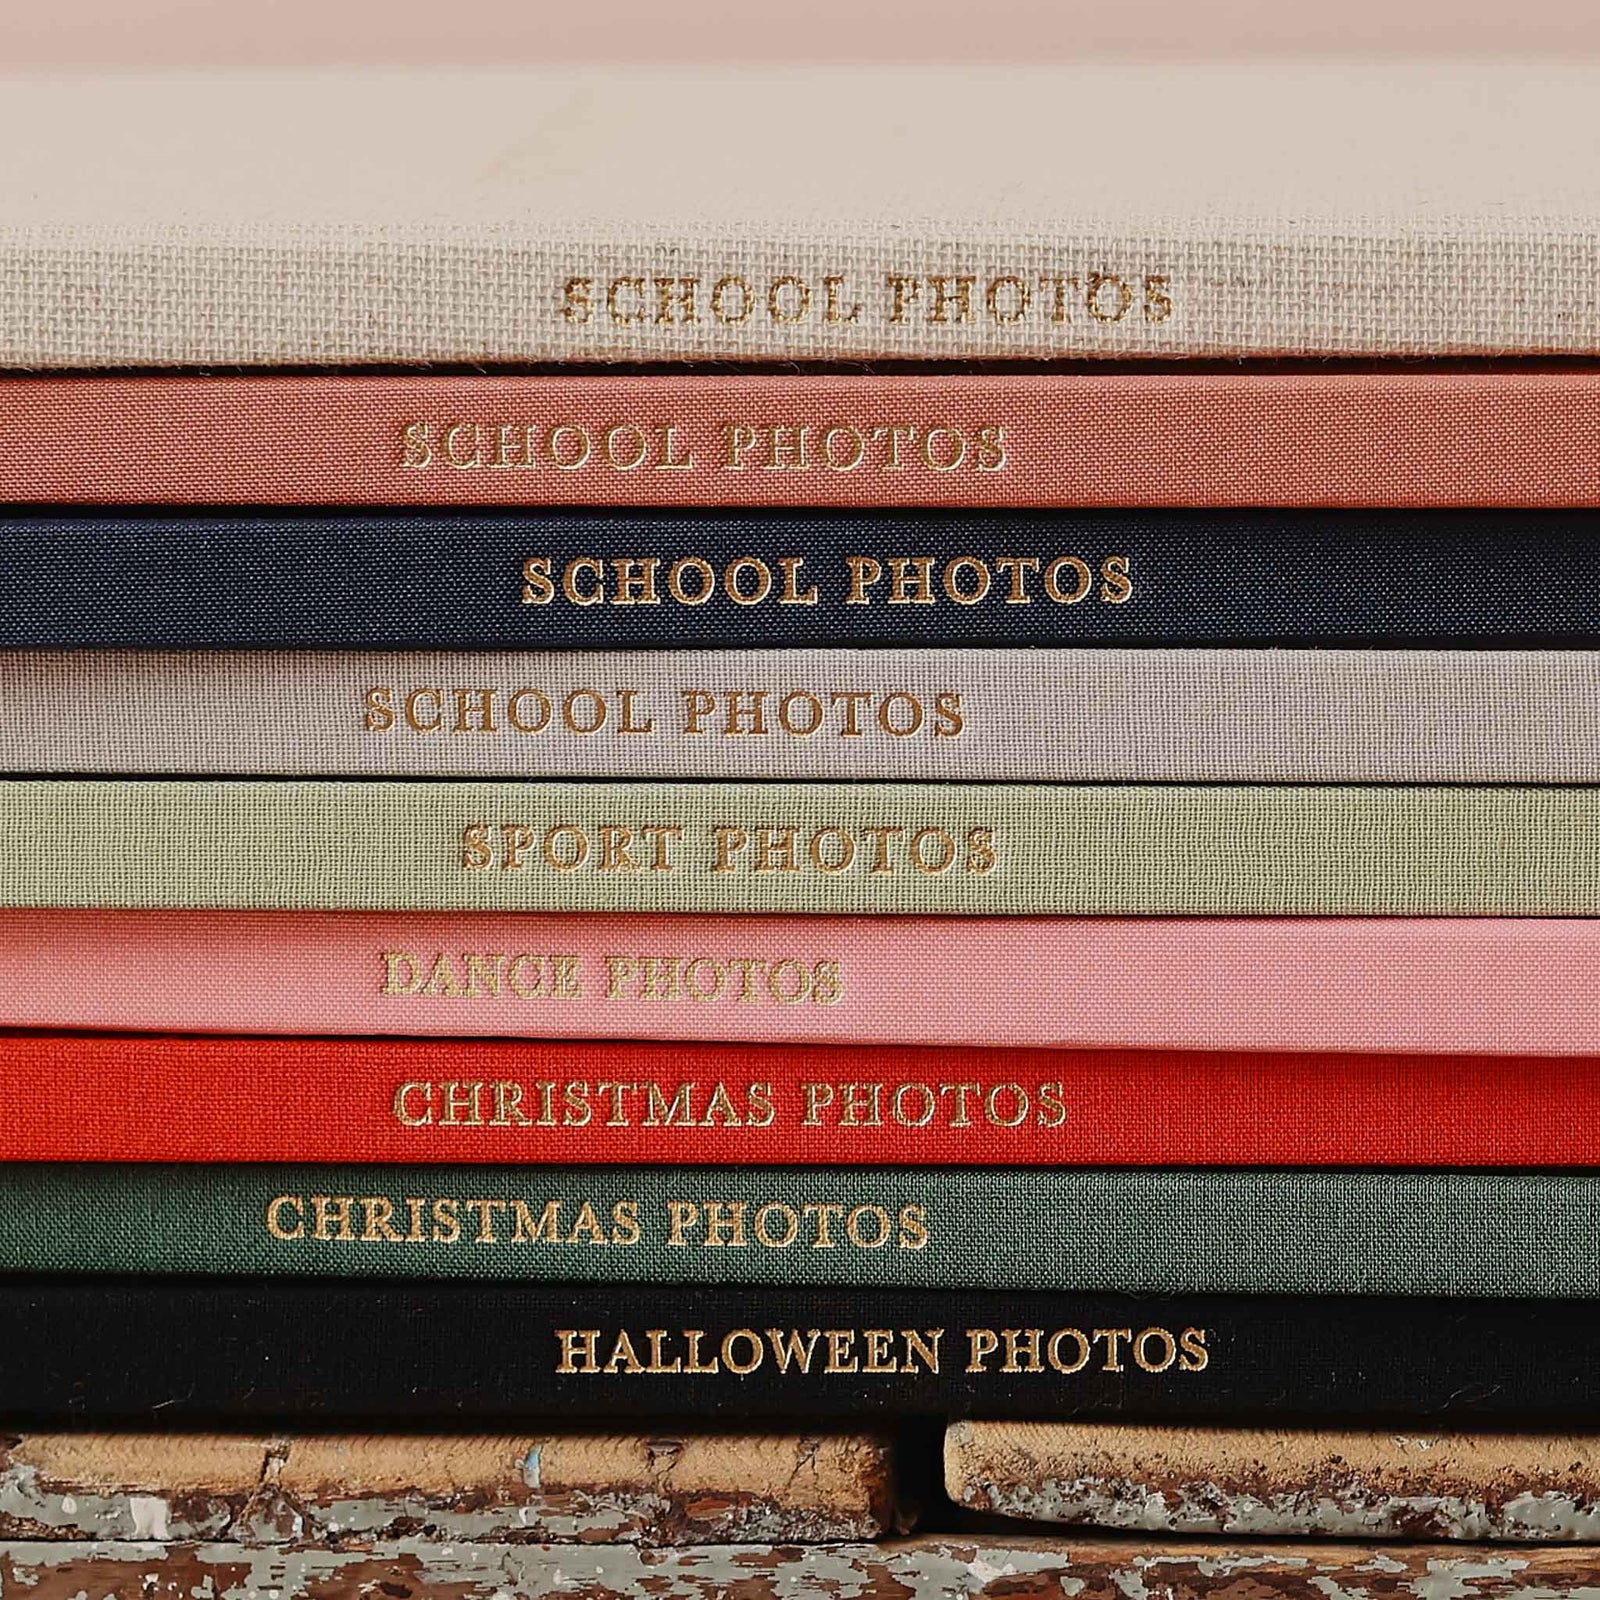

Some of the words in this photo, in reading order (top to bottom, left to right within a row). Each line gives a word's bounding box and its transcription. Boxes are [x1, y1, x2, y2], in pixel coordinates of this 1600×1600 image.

[564, 274, 859, 325] SCHOOL
[890, 272, 1173, 326] PHOTOS
[402, 424, 695, 473] SCHOOL
[723, 426, 1010, 476] PHOTOS
[521, 557, 819, 607] SCHOOL
[847, 556, 1134, 607] PHOTOS
[366, 689, 653, 735] SCHOOL
[683, 692, 963, 739] PHOTOS
[462, 826, 682, 871] SPORT
[713, 828, 998, 876] PHOTOS
[381, 952, 582, 997] DANCE
[606, 957, 845, 1005] PHOTOS
[393, 1082, 778, 1129] CHRISTMAS
[803, 1082, 1067, 1129] PHOTOS
[265, 1195, 641, 1248] CHRISTMAS
[666, 1202, 929, 1251] PHOTOS
[555, 1329, 941, 1377] HALLOWEEN
[965, 1327, 1210, 1375] PHOTOS
